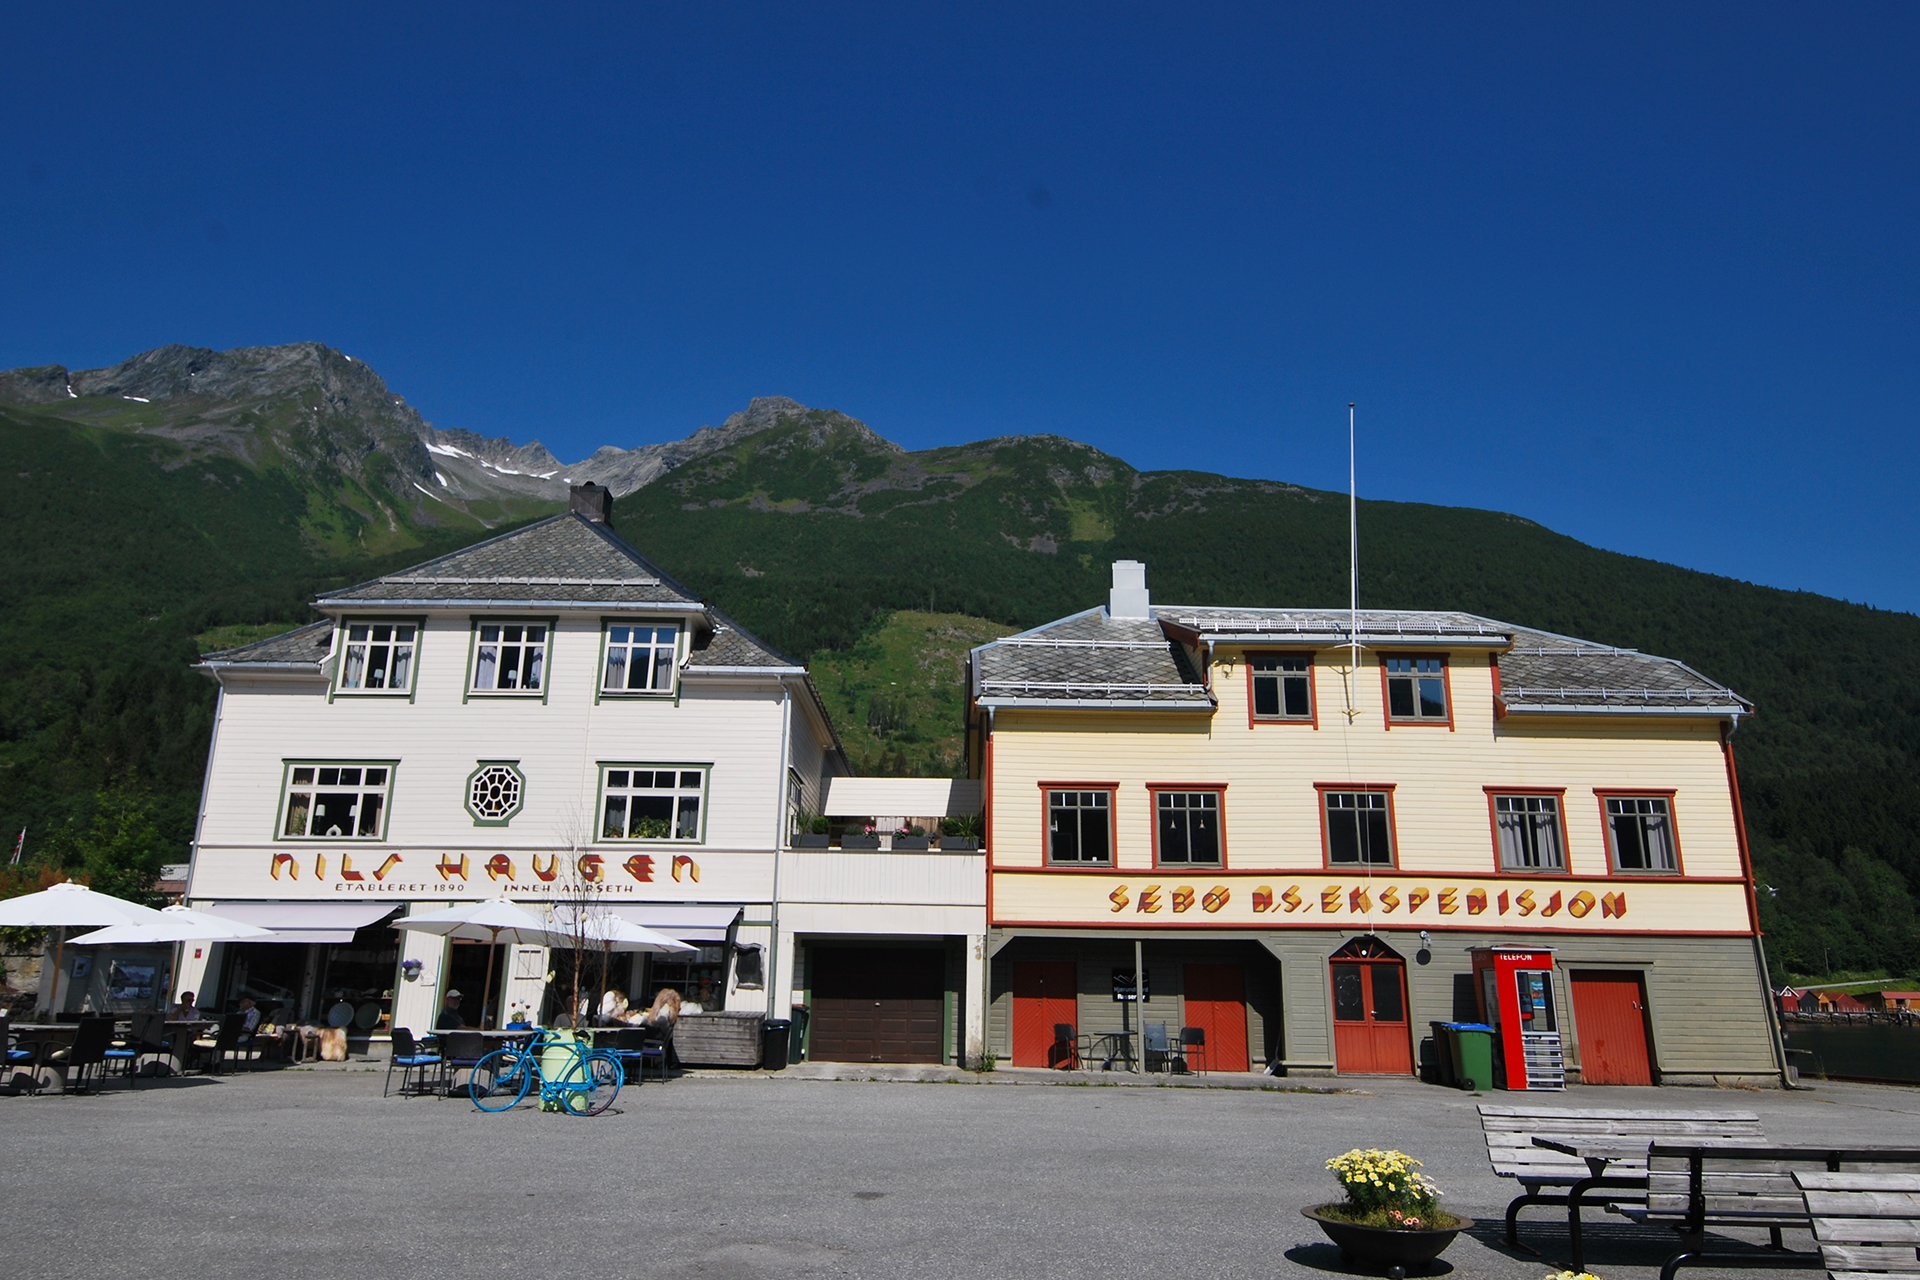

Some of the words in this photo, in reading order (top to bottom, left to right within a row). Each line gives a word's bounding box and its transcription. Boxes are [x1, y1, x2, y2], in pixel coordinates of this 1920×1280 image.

[335, 883, 428, 892] ETABLERET
[434, 884, 465, 892] 1890
[561, 885, 634, 894] AARSETH
[1109, 884, 1231, 914] SÆBØ
[1500, 953, 1533, 961] TELEFON
